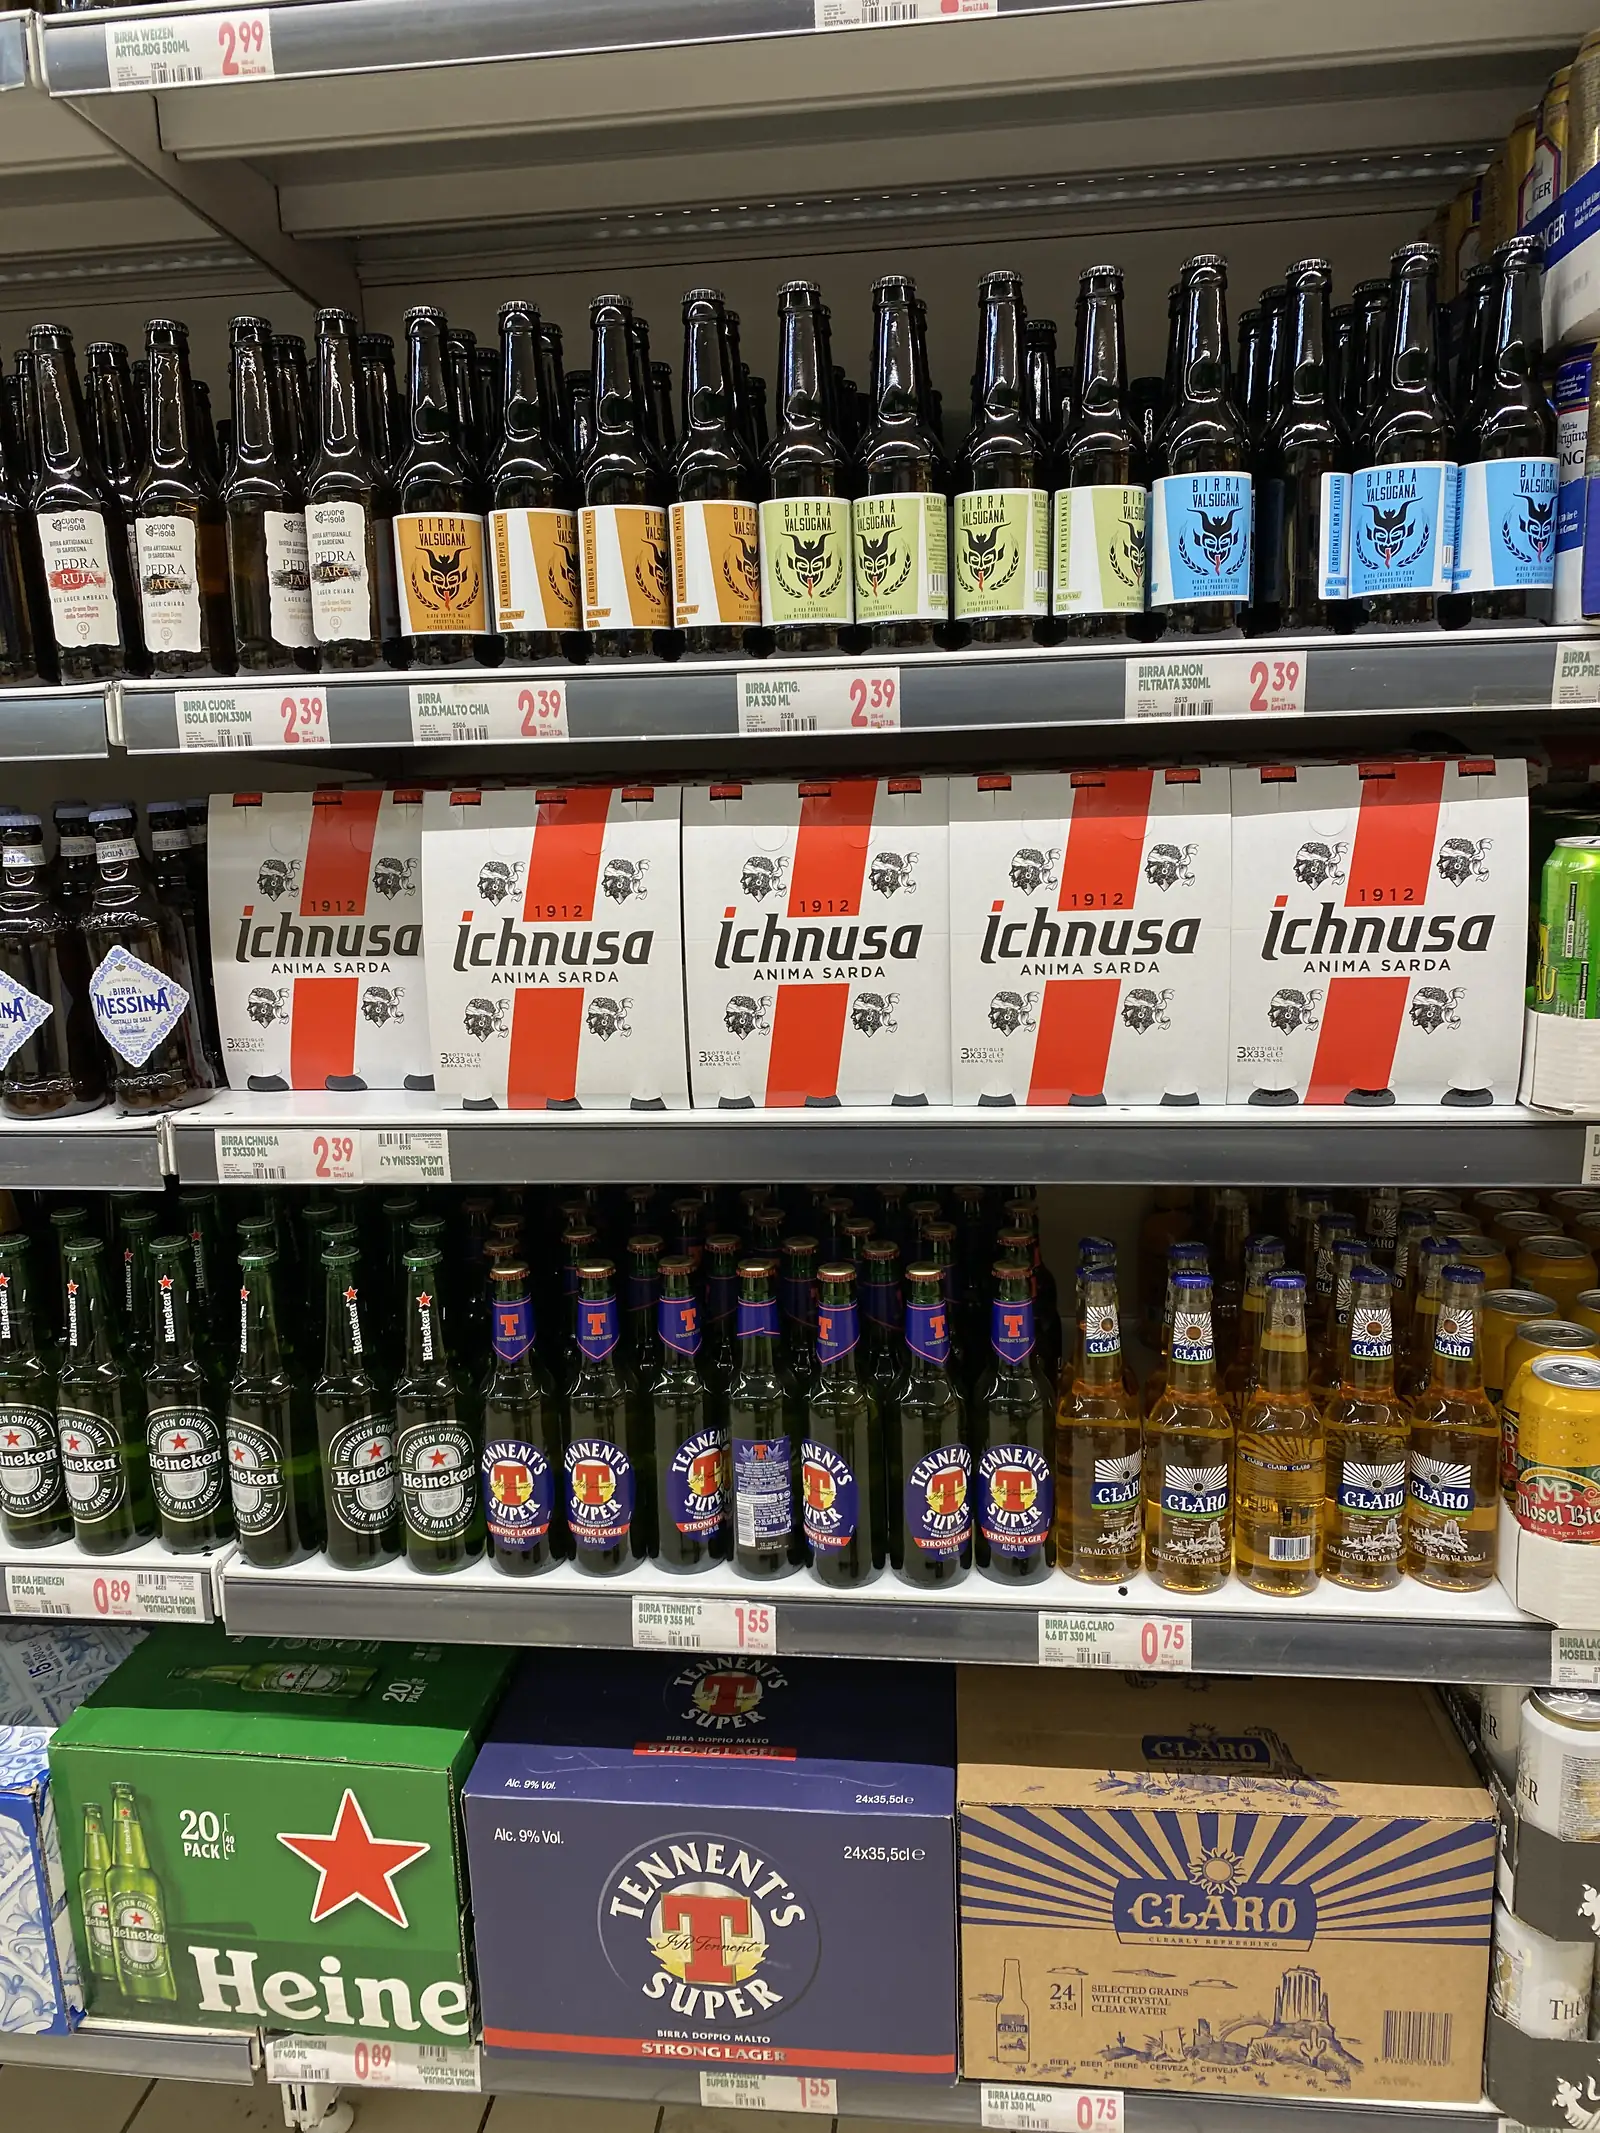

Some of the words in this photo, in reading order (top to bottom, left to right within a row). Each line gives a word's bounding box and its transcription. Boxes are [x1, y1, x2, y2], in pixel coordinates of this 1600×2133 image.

[114, 30, 139, 44] BIRRA
[141, 27, 174, 41] WEIZEN
[115, 43, 160, 57] ARTIG.RDG
[163, 40, 190, 55] 500ML
[1192, 478, 1240, 493] BIRRA
[1367, 469, 1417, 488] BIRRA
[1367, 484, 1416, 502] VALSUGANA
[1193, 493, 1240, 508] VALSUGANA
[784, 503, 832, 516] BIRRA
[418, 519, 465, 532] BIRRA
[785, 517, 832, 532] VALSUGANA
[419, 533, 466, 547] VALSUGANA
[315, 551, 356, 562] PEDRA
[54, 558, 99, 570] PEDRA
[61, 573, 97, 585] RUJA
[320, 566, 350, 578] JARA
[503, 598, 509, 607] LA
[1563, 652, 1590, 663] BIRRA
[1138, 665, 1165, 678] BIRRA
[1167, 664, 1203, 677] AR.NON
[745, 682, 770, 694] BIRRA
[772, 681, 800, 692] ARTIG.
[1138, 678, 1180, 691] FILTRATA
[1181, 677, 1211, 689] 330ML
[417, 693, 442, 704] BIRRA
[746, 696, 760, 707] IPA
[761, 695, 776, 706] 330
[778, 695, 790, 705] ML
[183, 700, 207, 712] BIRRA
[208, 700, 236, 710] CUORE
[419, 705, 468, 717] AR.D.MALTO
[470, 704, 489, 715] CHIA
[184, 713, 208, 724] ISOLA
[1070, 893, 1124, 906] 1912
[1359, 888, 1415, 902] 1912
[534, 905, 583, 918] 1912
[714, 906, 923, 969] ichnusa
[980, 900, 1202, 964] ichnusa
[453, 910, 655, 972] ichnusa
[753, 967, 814, 980] ANIMA
[822, 965, 886, 979] SARDA
[1020, 963, 1083, 976] ANIMA
[1093, 961, 1159, 975] SARDA
[1303, 959, 1371, 973] ANIMA
[1381, 958, 1451, 972] SARDA
[491, 972, 549, 984] ANIMA
[558, 970, 619, 982] SARDA
[113, 986, 137, 996] BIRRA
[94, 987, 171, 1019] MESSINA
[221, 1136, 243, 1146] BIRRA
[244, 1136, 279, 1146] ICHNUSA
[222, 1147, 232, 1157] BT
[233, 1147, 255, 1157] 3X330
[257, 1148, 268, 1157] ML
[392, 1155, 443, 1166] LAG.MESSINA
[422, 1167, 444, 1176] BIRRA
[419, 1309, 433, 1361] Heineken
[405, 1435, 436, 1464] HEINEKEN
[438, 1432, 470, 1457] ORIGINAL
[149, 1448, 222, 1471] Heineken
[481, 1442, 548, 1477] TENNENT'S
[402, 1462, 475, 1489] Heineken
[1343, 1490, 1404, 1510] CLARO
[1410, 1480, 1469, 1510] CLARO
[489, 1497, 542, 1521] SUPER
[1165, 1494, 1226, 1513] CLARO
[1517, 1490, 1563, 1526] Mosel
[411, 1505, 429, 1527] PURE
[431, 1514, 453, 1529] MALT
[454, 1495, 473, 1525] LAGER
[490, 1524, 518, 1536] STRONG
[519, 1526, 541, 1536] LAGER
[1552, 1527, 1575, 1538] Lager
[1576, 1529, 1595, 1537] Beer
[12, 1575, 31, 1585] BIRRA
[32, 1576, 65, 1586] HEINEKEN
[13, 1585, 21, 1594] BT
[22, 1586, 35, 1595] 400
[36, 1587, 46, 1595] ML
[638, 1603, 660, 1613] BIRRA
[662, 1604, 696, 1615] TENNENT
[697, 1606, 702, 1615] S
[638, 1614, 663, 1624] SUPER
[664, 1616, 668, 1624] 9
[669, 1616, 682, 1625] 355
[685, 1617, 695, 1626] ML
[1046, 1620, 1068, 1630] BIRRA
[1070, 1621, 1114, 1632] LAG.CLARO
[1045, 1631, 1057, 1641] 4.6
[1058, 1632, 1067, 1641] BT
[1069, 1632, 1084, 1642] 330
[1085, 1633, 1097, 1642] ML
[1560, 1649, 1596, 1661] MOSELB.
[681, 1708, 766, 1730] SUPER
[179, 1809, 220, 1843] 20
[226, 1835, 235, 1844] 40
[494, 1828, 517, 1843] Alc.
[519, 1829, 540, 1844] 9%
[542, 1830, 564, 1845] Vol.
[183, 1843, 221, 1860] PACK
[226, 1844, 235, 1853] CL
[843, 1845, 910, 1862] 24x35,5cl
[609, 1842, 806, 1928] TENNENT'S
[1127, 1892, 1297, 1934] CLARO
[1148, 1936, 1199, 1944] CLEARLY
[1205, 1938, 1278, 1948] REFRESHING
[187, 1944, 469, 2037] Heine
[642, 1971, 784, 2020] SUPER
[1050, 1983, 1075, 2000] 24
[1091, 1984, 1146, 1996] SELECTED
[1149, 1987, 1189, 1997] GRAINS
[1050, 2001, 1077, 2012] x33cl
[1091, 1994, 1121, 2005] WITH
[1123, 1996, 1172, 2006] CRYSTAL
[1091, 2004, 1126, 2014] CLEAR
[1129, 2006, 1167, 2015] WATER
[657, 2029, 688, 2039] BIRRA
[692, 2031, 730, 2042] DOPPIO
[734, 2034, 771, 2044] MALTO
[641, 2042, 722, 2059] STRONG
[725, 2047, 786, 2061] LAGER
[1114, 2062, 1139, 2070] BIERE
[1149, 2064, 1189, 2072] CERVEZA
[1200, 2066, 1239, 2074] CERVEJA
